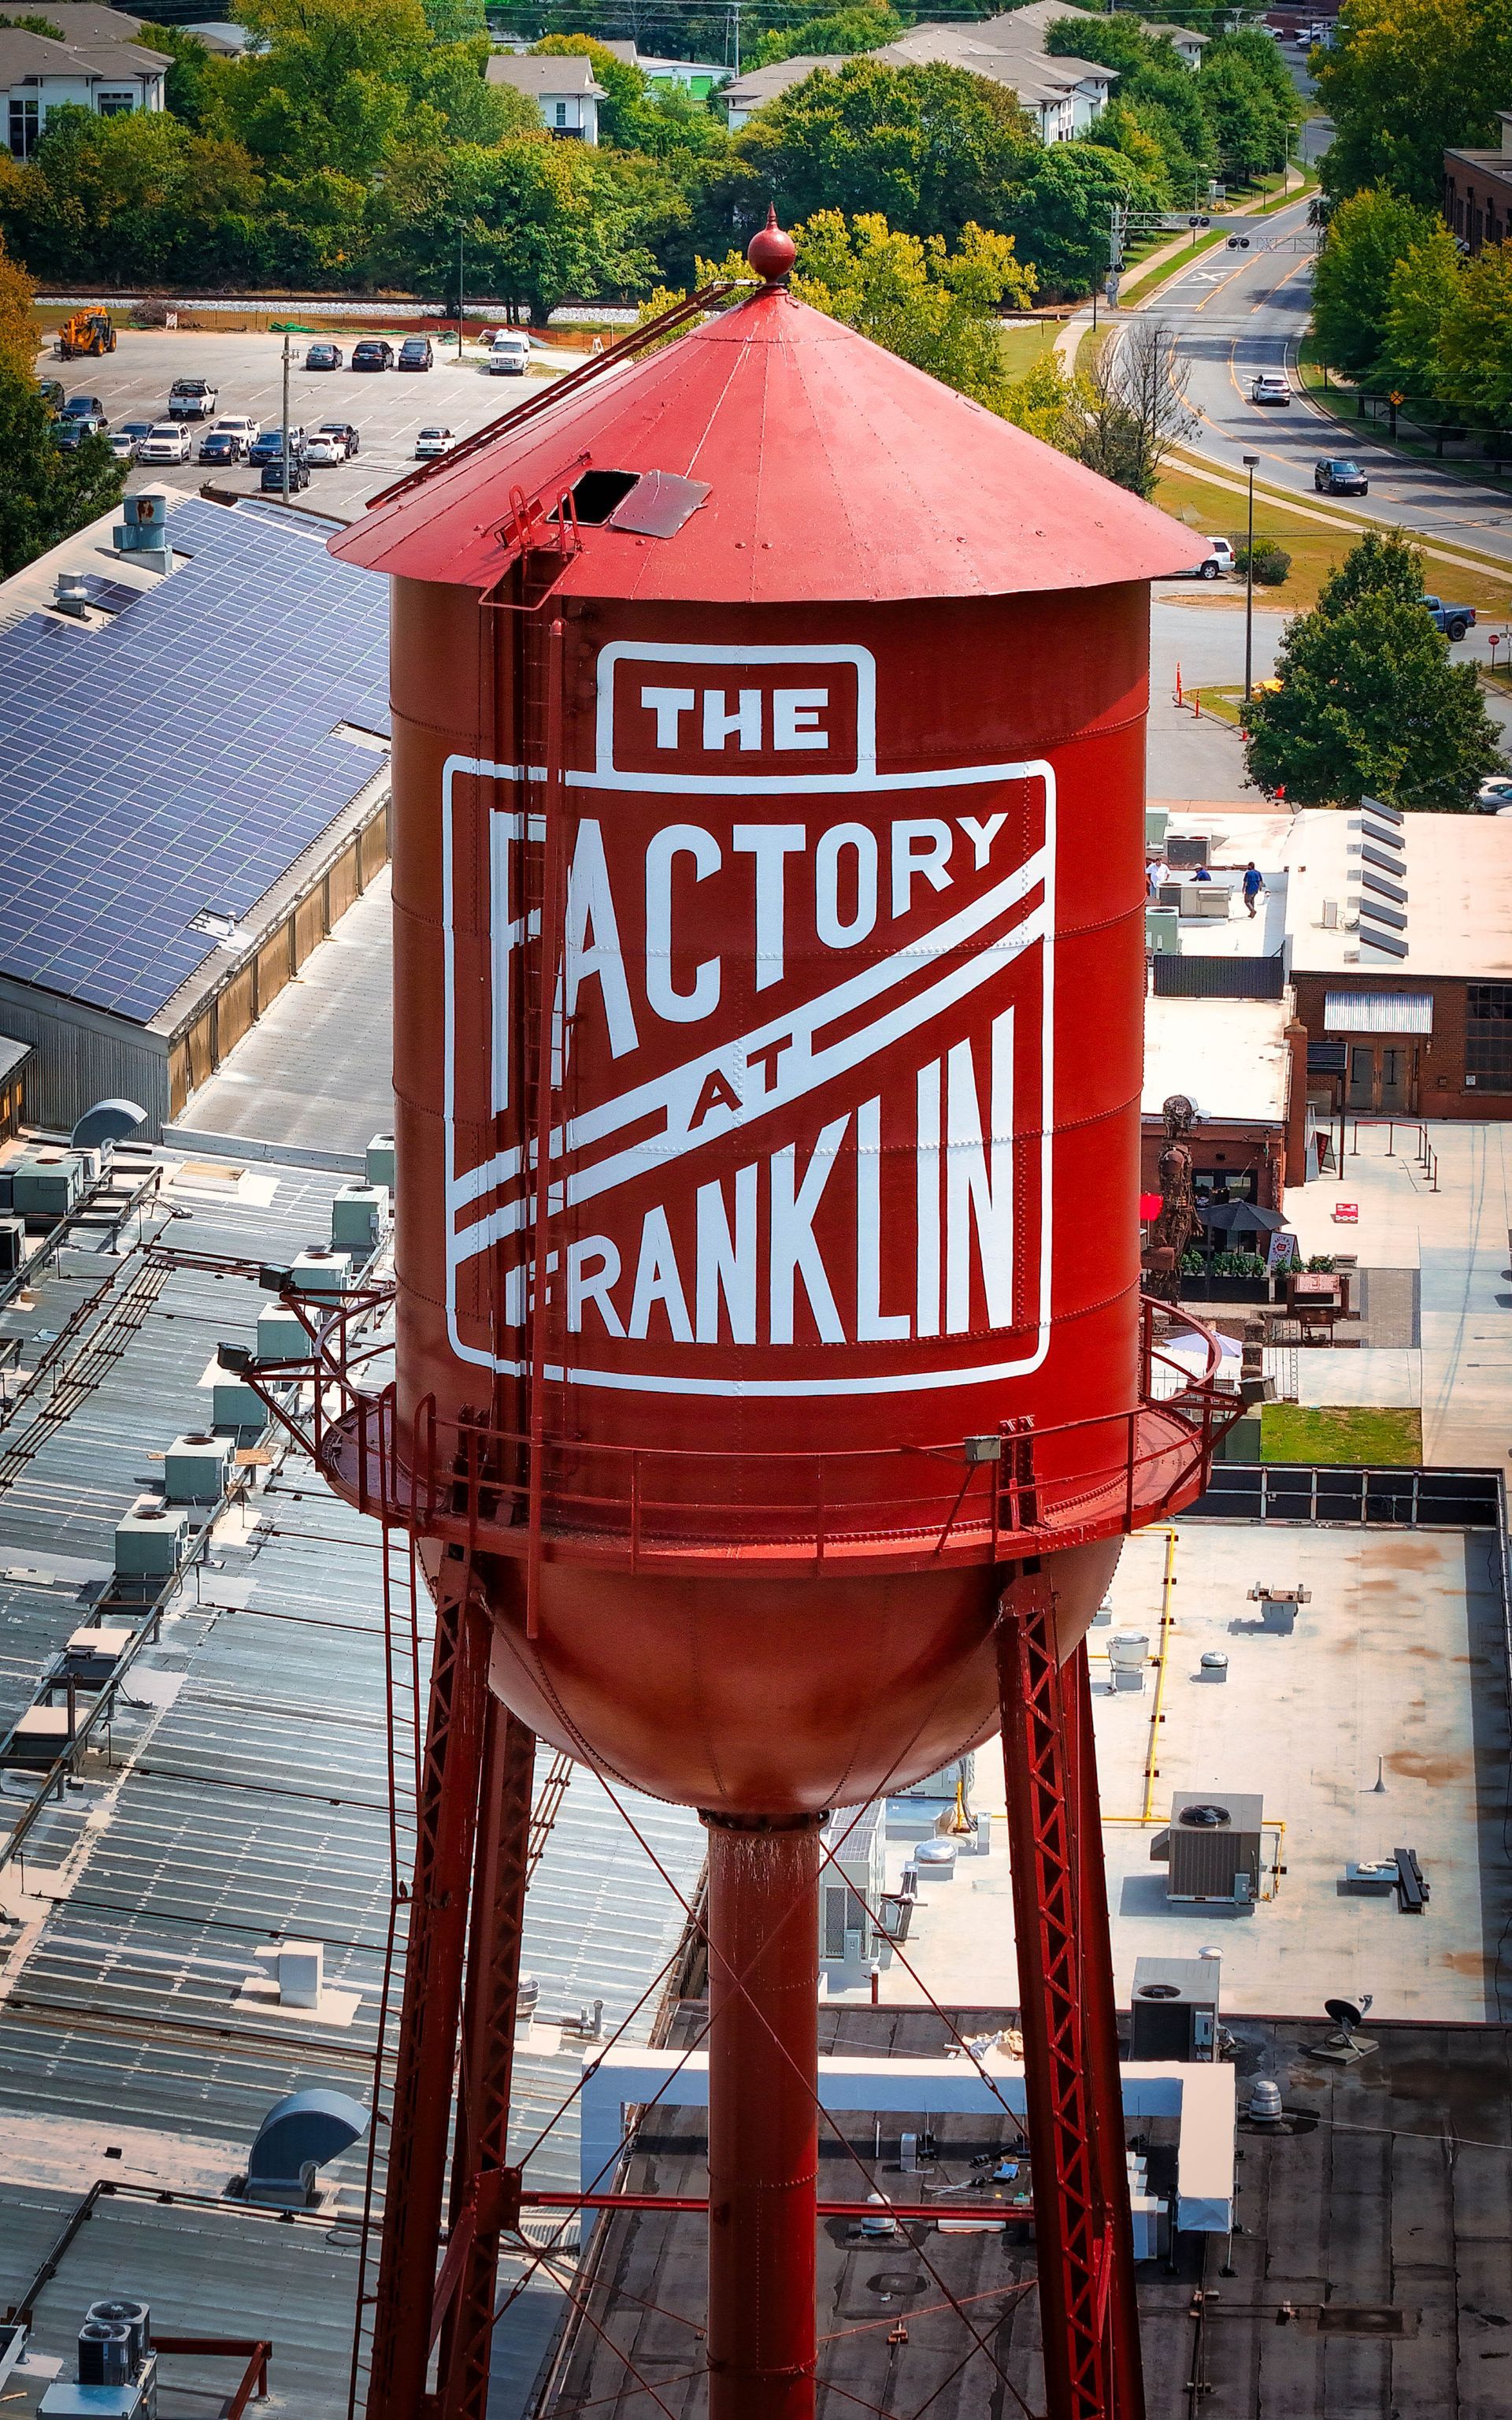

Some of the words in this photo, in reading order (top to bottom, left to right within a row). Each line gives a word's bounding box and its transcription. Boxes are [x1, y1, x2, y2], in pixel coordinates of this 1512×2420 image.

[641, 686, 828, 751] THE
[489, 807, 1009, 1120] FACTORY
[505, 1004, 1015, 1345] FRANKLIN
[687, 1032, 793, 1133] AT
